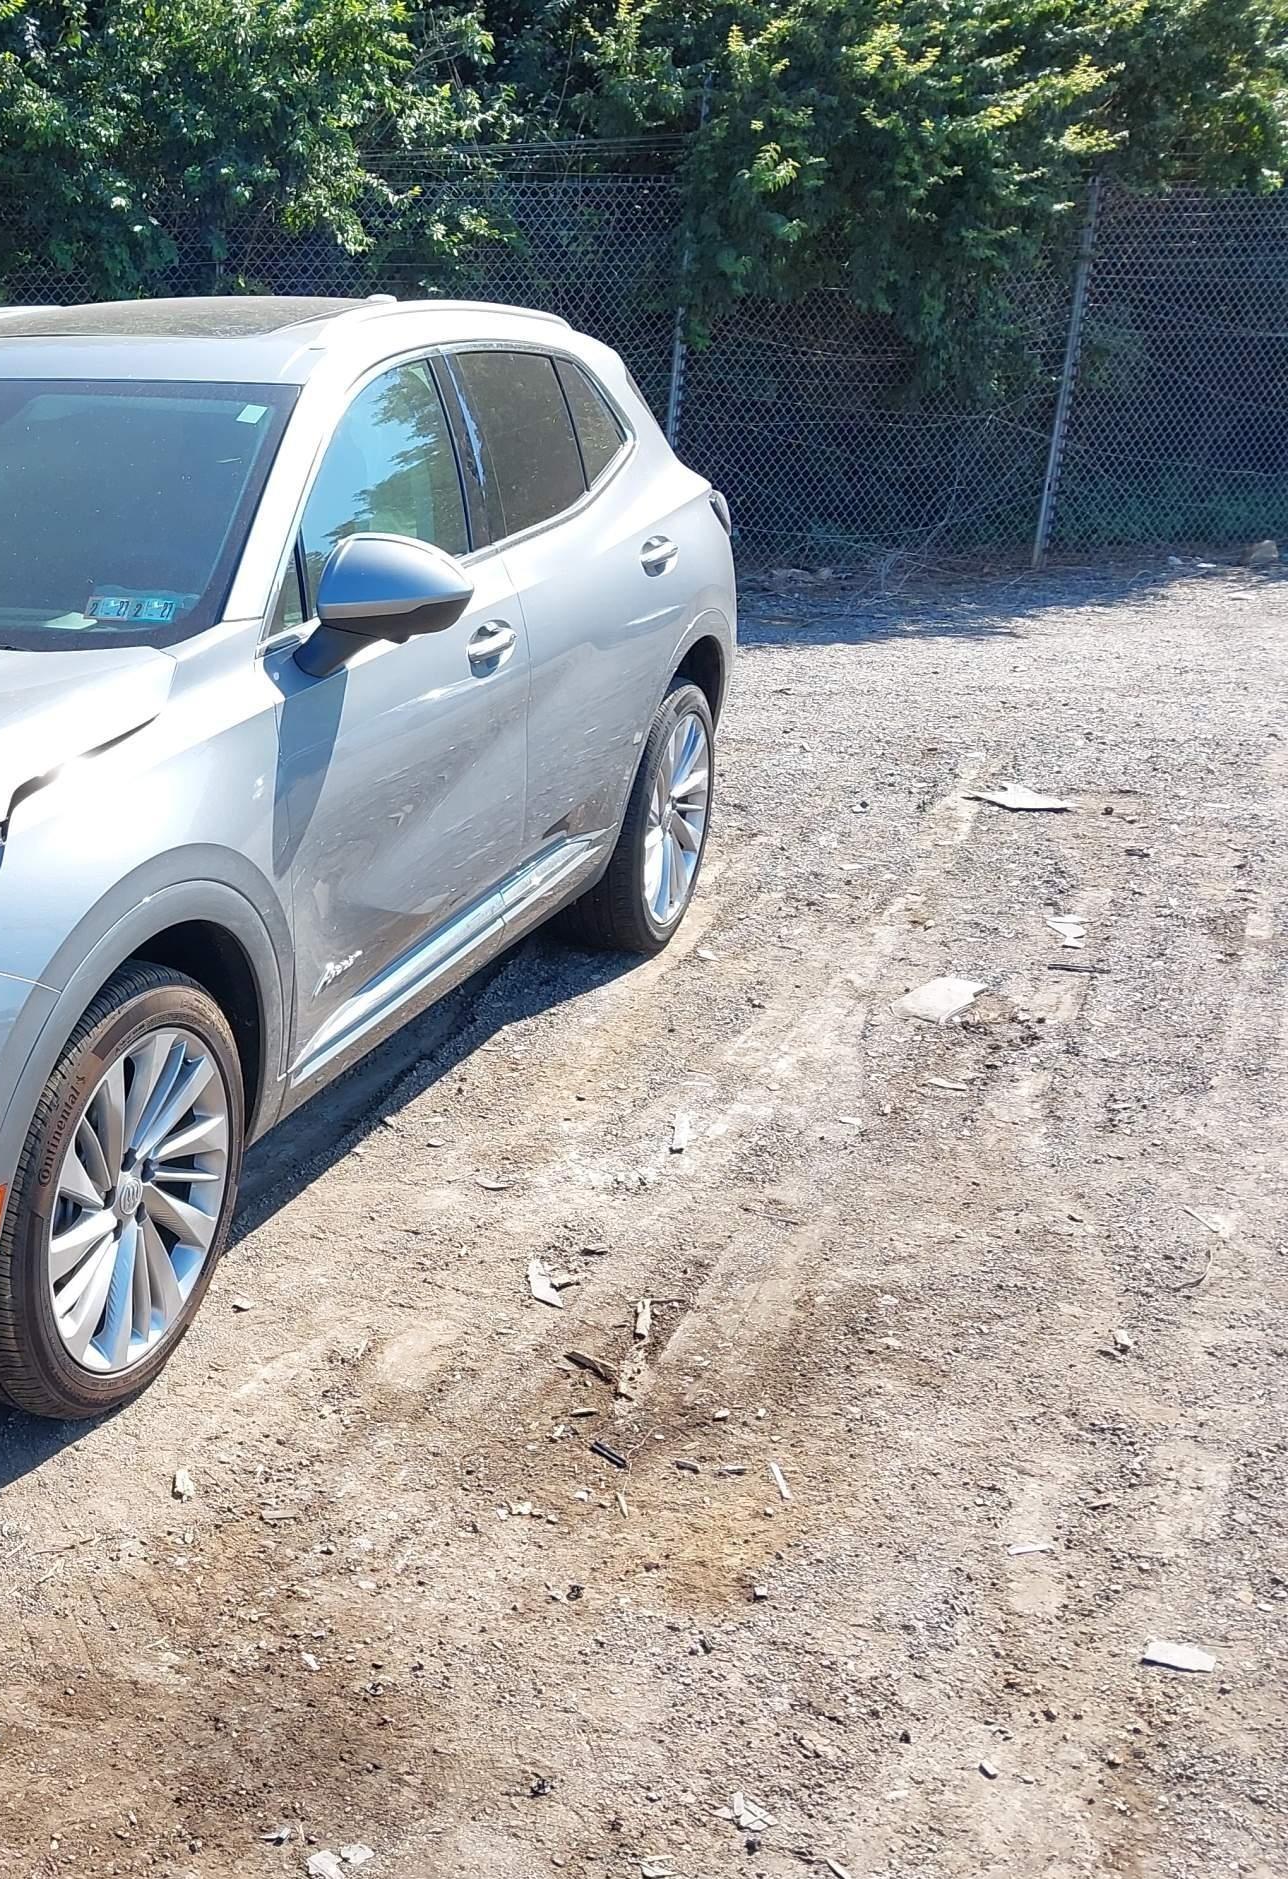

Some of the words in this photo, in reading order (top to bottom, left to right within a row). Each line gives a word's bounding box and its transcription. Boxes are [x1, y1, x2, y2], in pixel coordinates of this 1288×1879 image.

[89, 602, 98, 617] 2
[116, 600, 130, 617] 27
[134, 603, 143, 617] 2
[160, 602, 174, 618] 27
[39, 1085, 81, 1187] Continental
